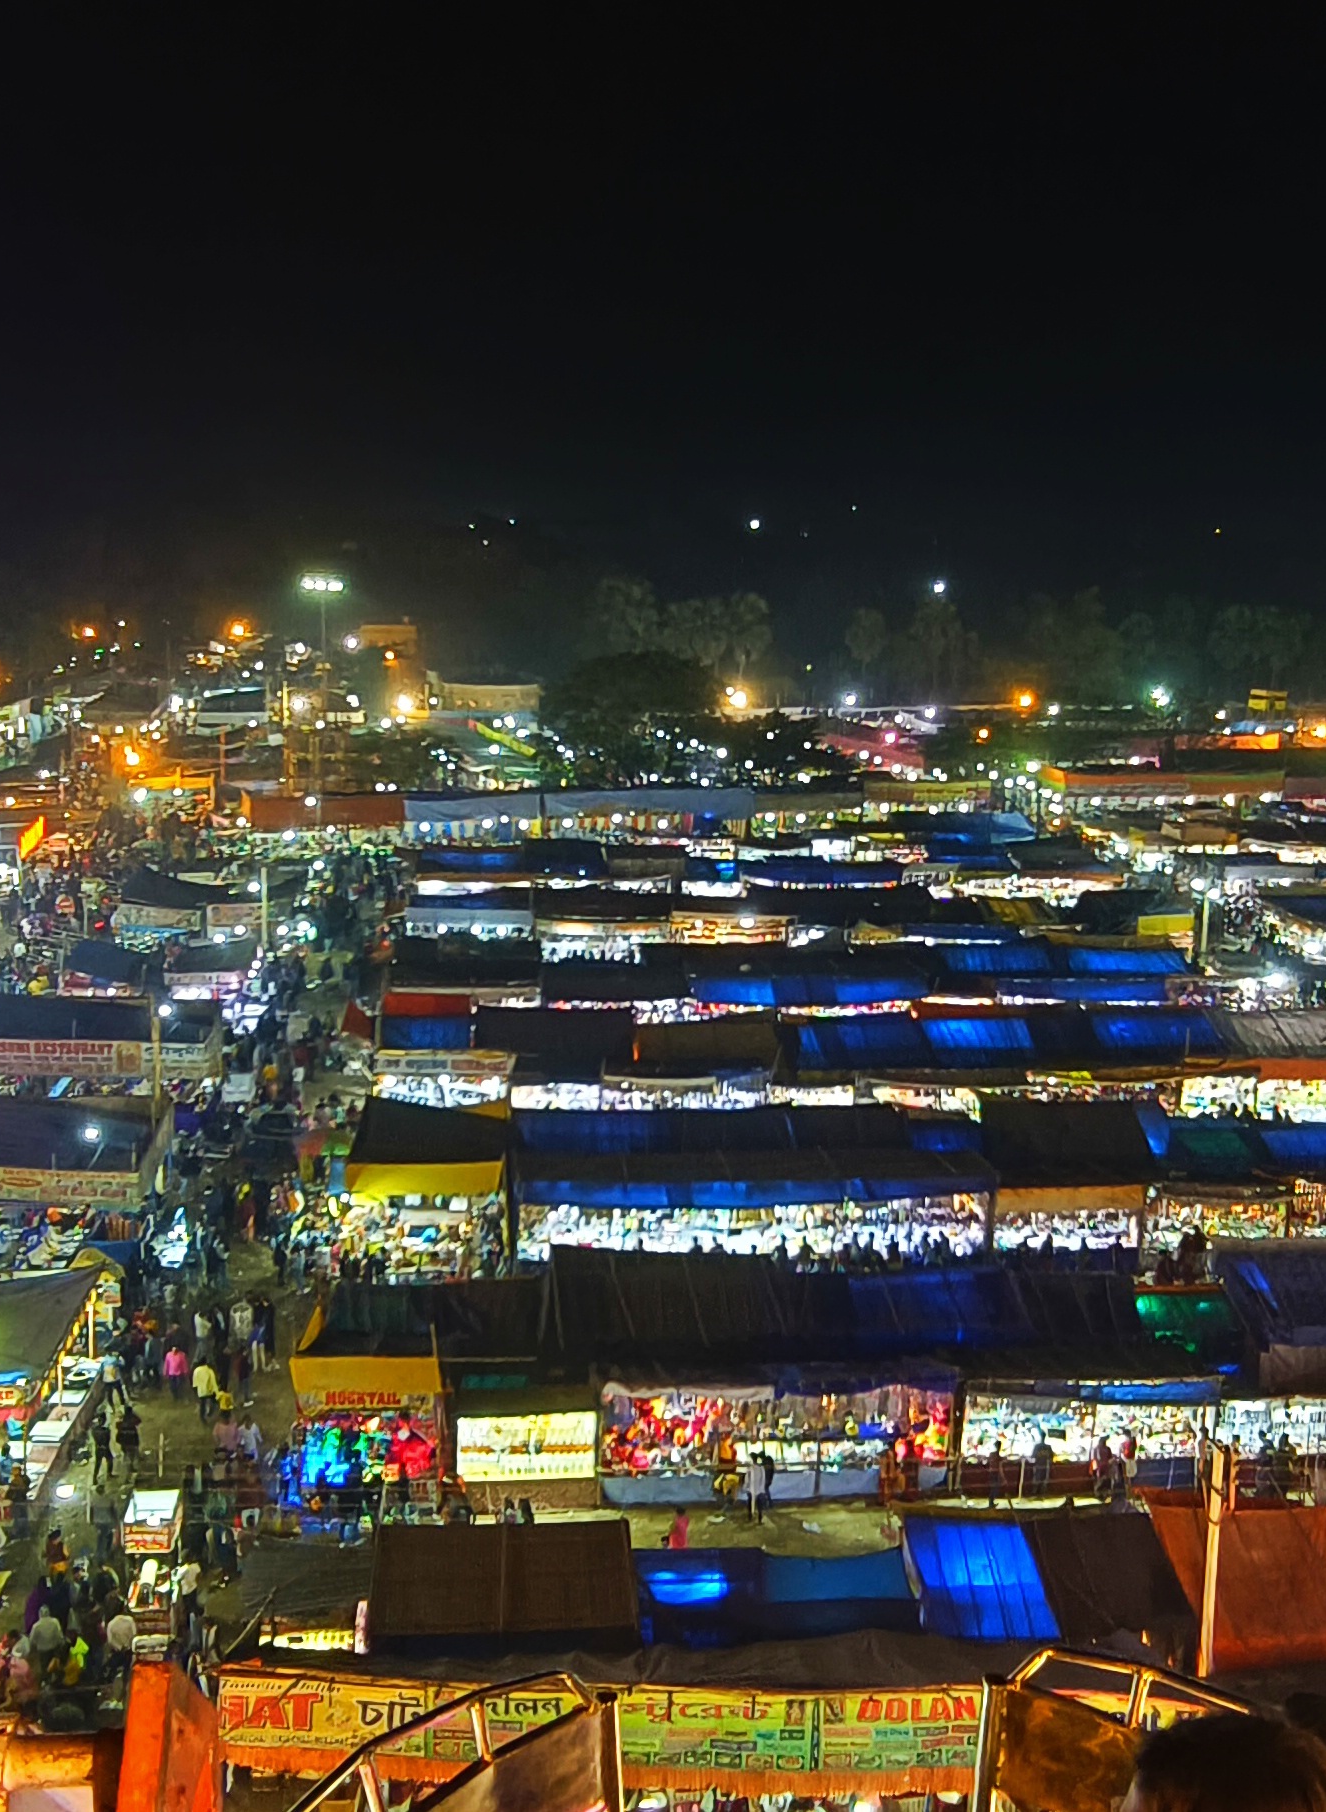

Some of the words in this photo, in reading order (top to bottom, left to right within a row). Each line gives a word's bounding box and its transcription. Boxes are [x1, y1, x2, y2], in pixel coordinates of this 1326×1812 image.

[34, 1042, 113, 1055] RESTAURANT
[325, 1391, 401, 1406] MOCKTAIL
[220, 1692, 324, 1732] HAT
[857, 1695, 977, 1723] DOLAN
